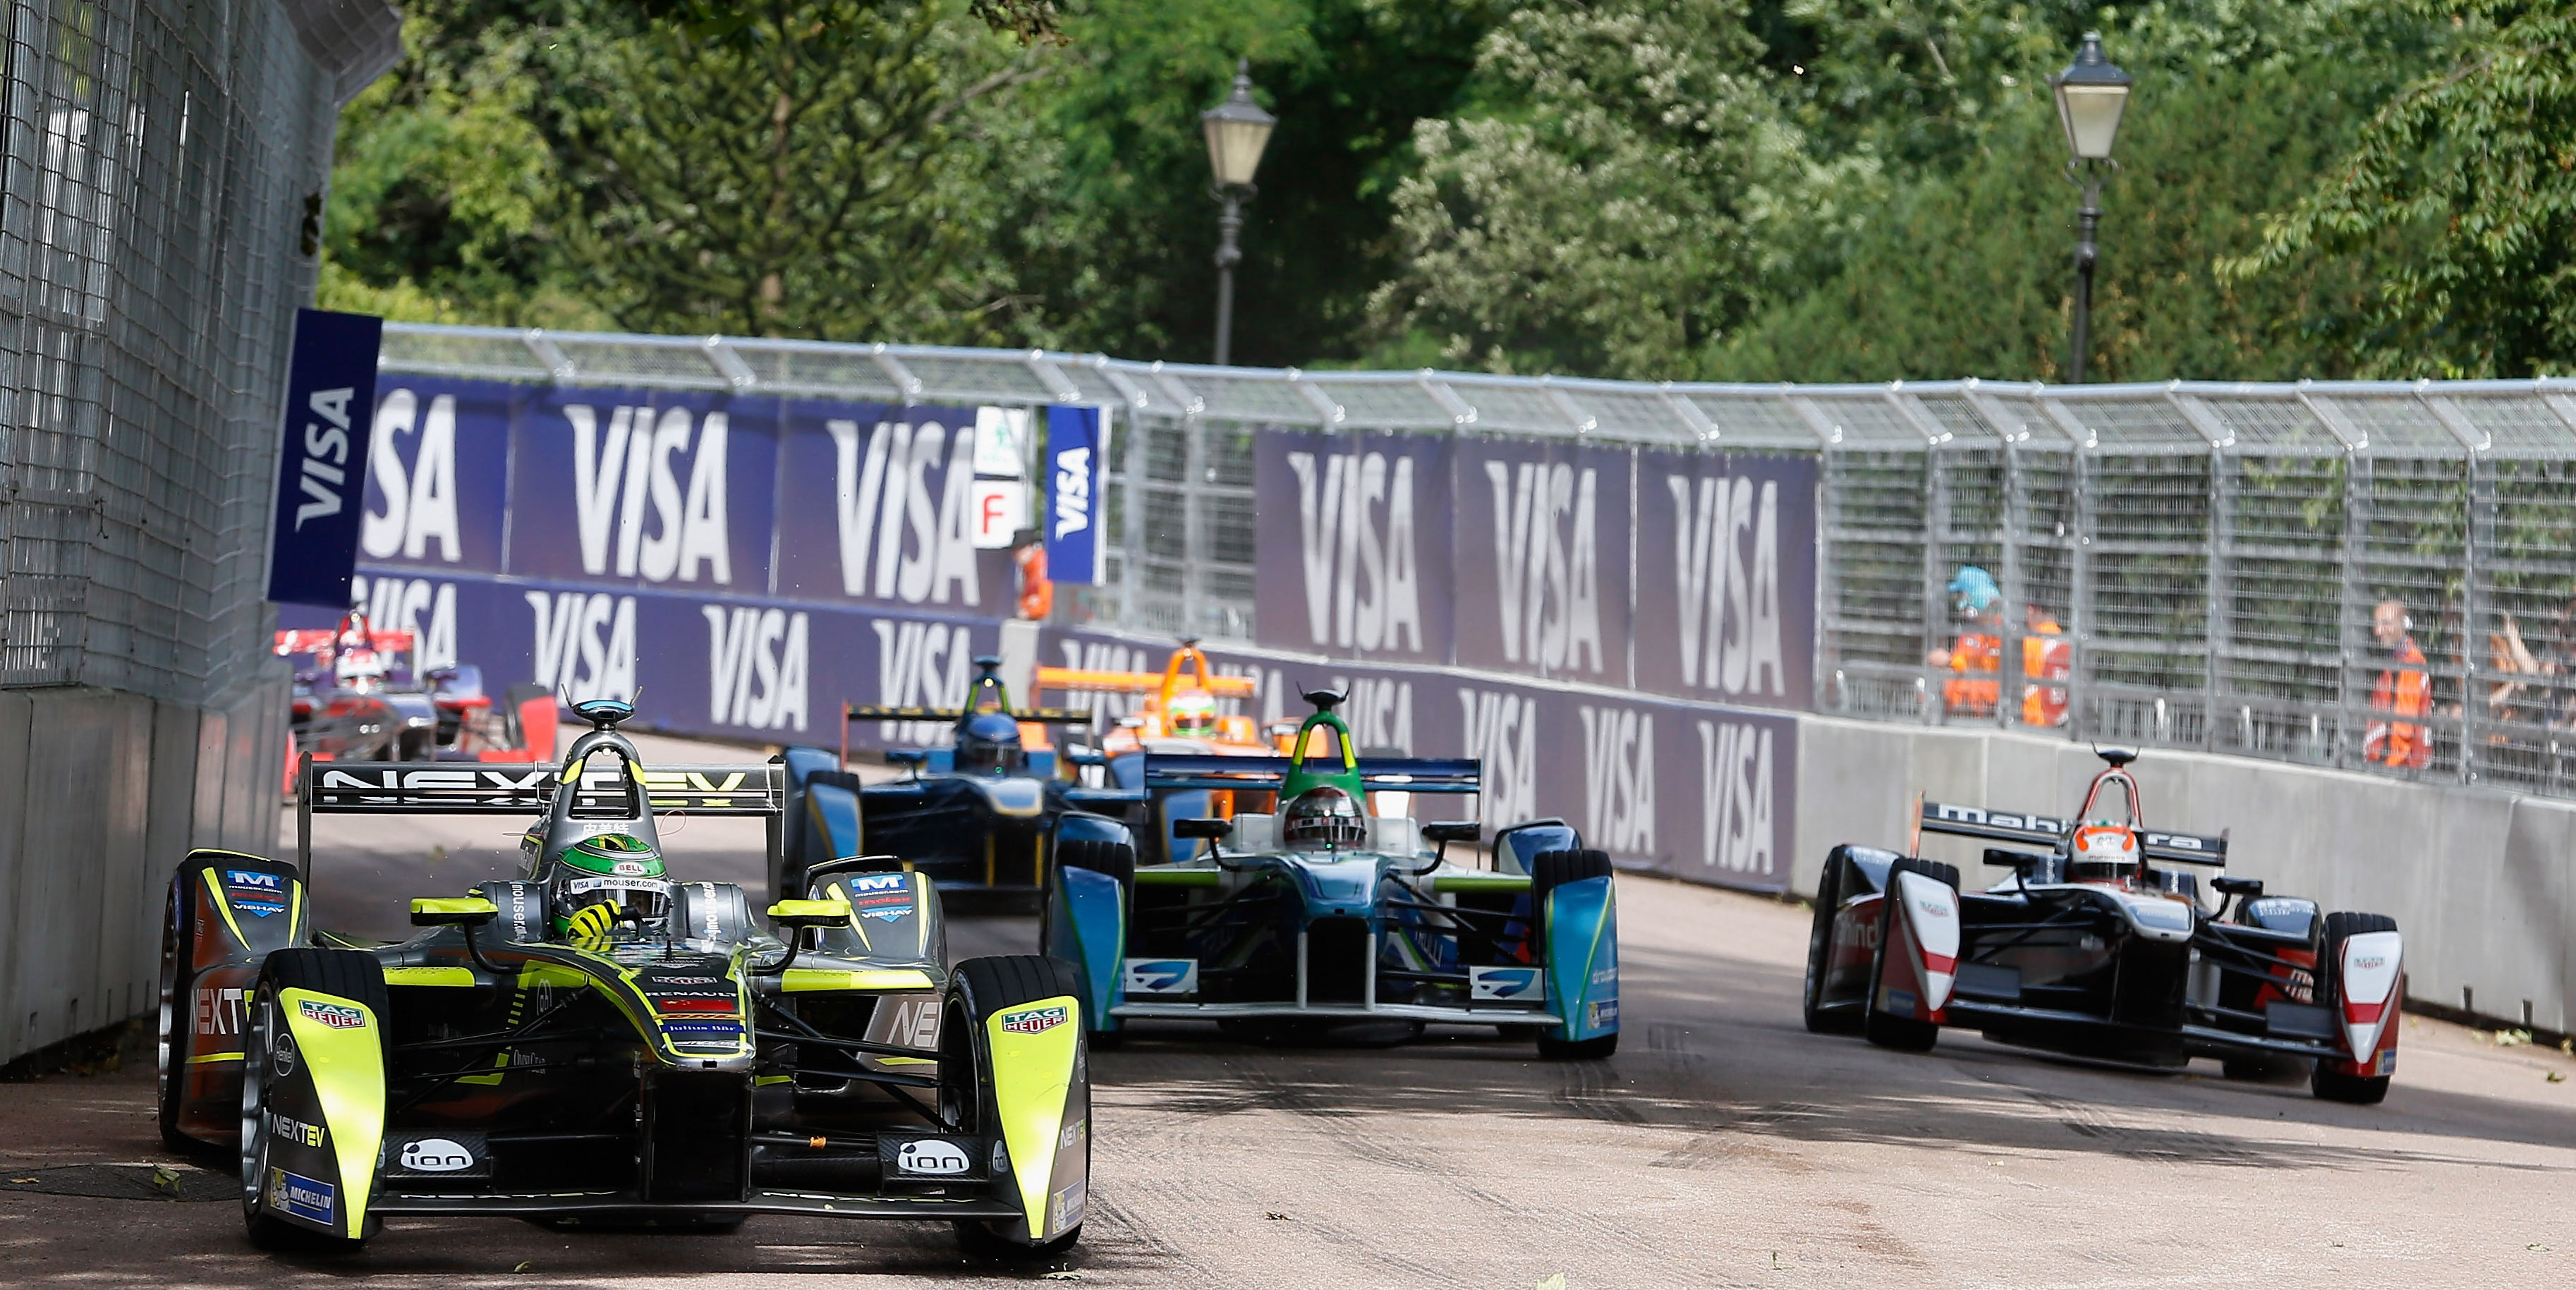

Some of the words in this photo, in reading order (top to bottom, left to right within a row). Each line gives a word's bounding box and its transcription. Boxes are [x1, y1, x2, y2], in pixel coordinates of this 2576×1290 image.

[295, 386, 355, 533] VISA
[361, 388, 462, 563] SA
[564, 404, 732, 584] VISA
[826, 421, 981, 607] VISA
[983, 494, 1005, 535] F
[1055, 446, 1091, 542] VISA
[1287, 451, 1423, 653] VISA
[1484, 460, 1604, 674] VISA
[1667, 475, 1787, 698] VISA
[525, 591, 637, 705] VISA
[702, 604, 810, 732] VISA
[871, 619, 971, 746] VISA
[1458, 688, 1536, 831] VISA
[1580, 705, 1655, 855] VISA
[1697, 721, 1774, 876] VISA
[604, 879, 658, 888] mouser.com
[304, 1009, 361, 1027] HEUER
[305, 1002, 358, 1018] TAG
[1006, 1017, 1065, 1033] HEUER
[1013, 1009, 1060, 1022] TAG
[272, 1114, 325, 1148] NEXTEV
[410, 1155, 466, 1167] ion
[906, 1155, 964, 1169] ion
[290, 1186, 332, 1210] MICHELIN
